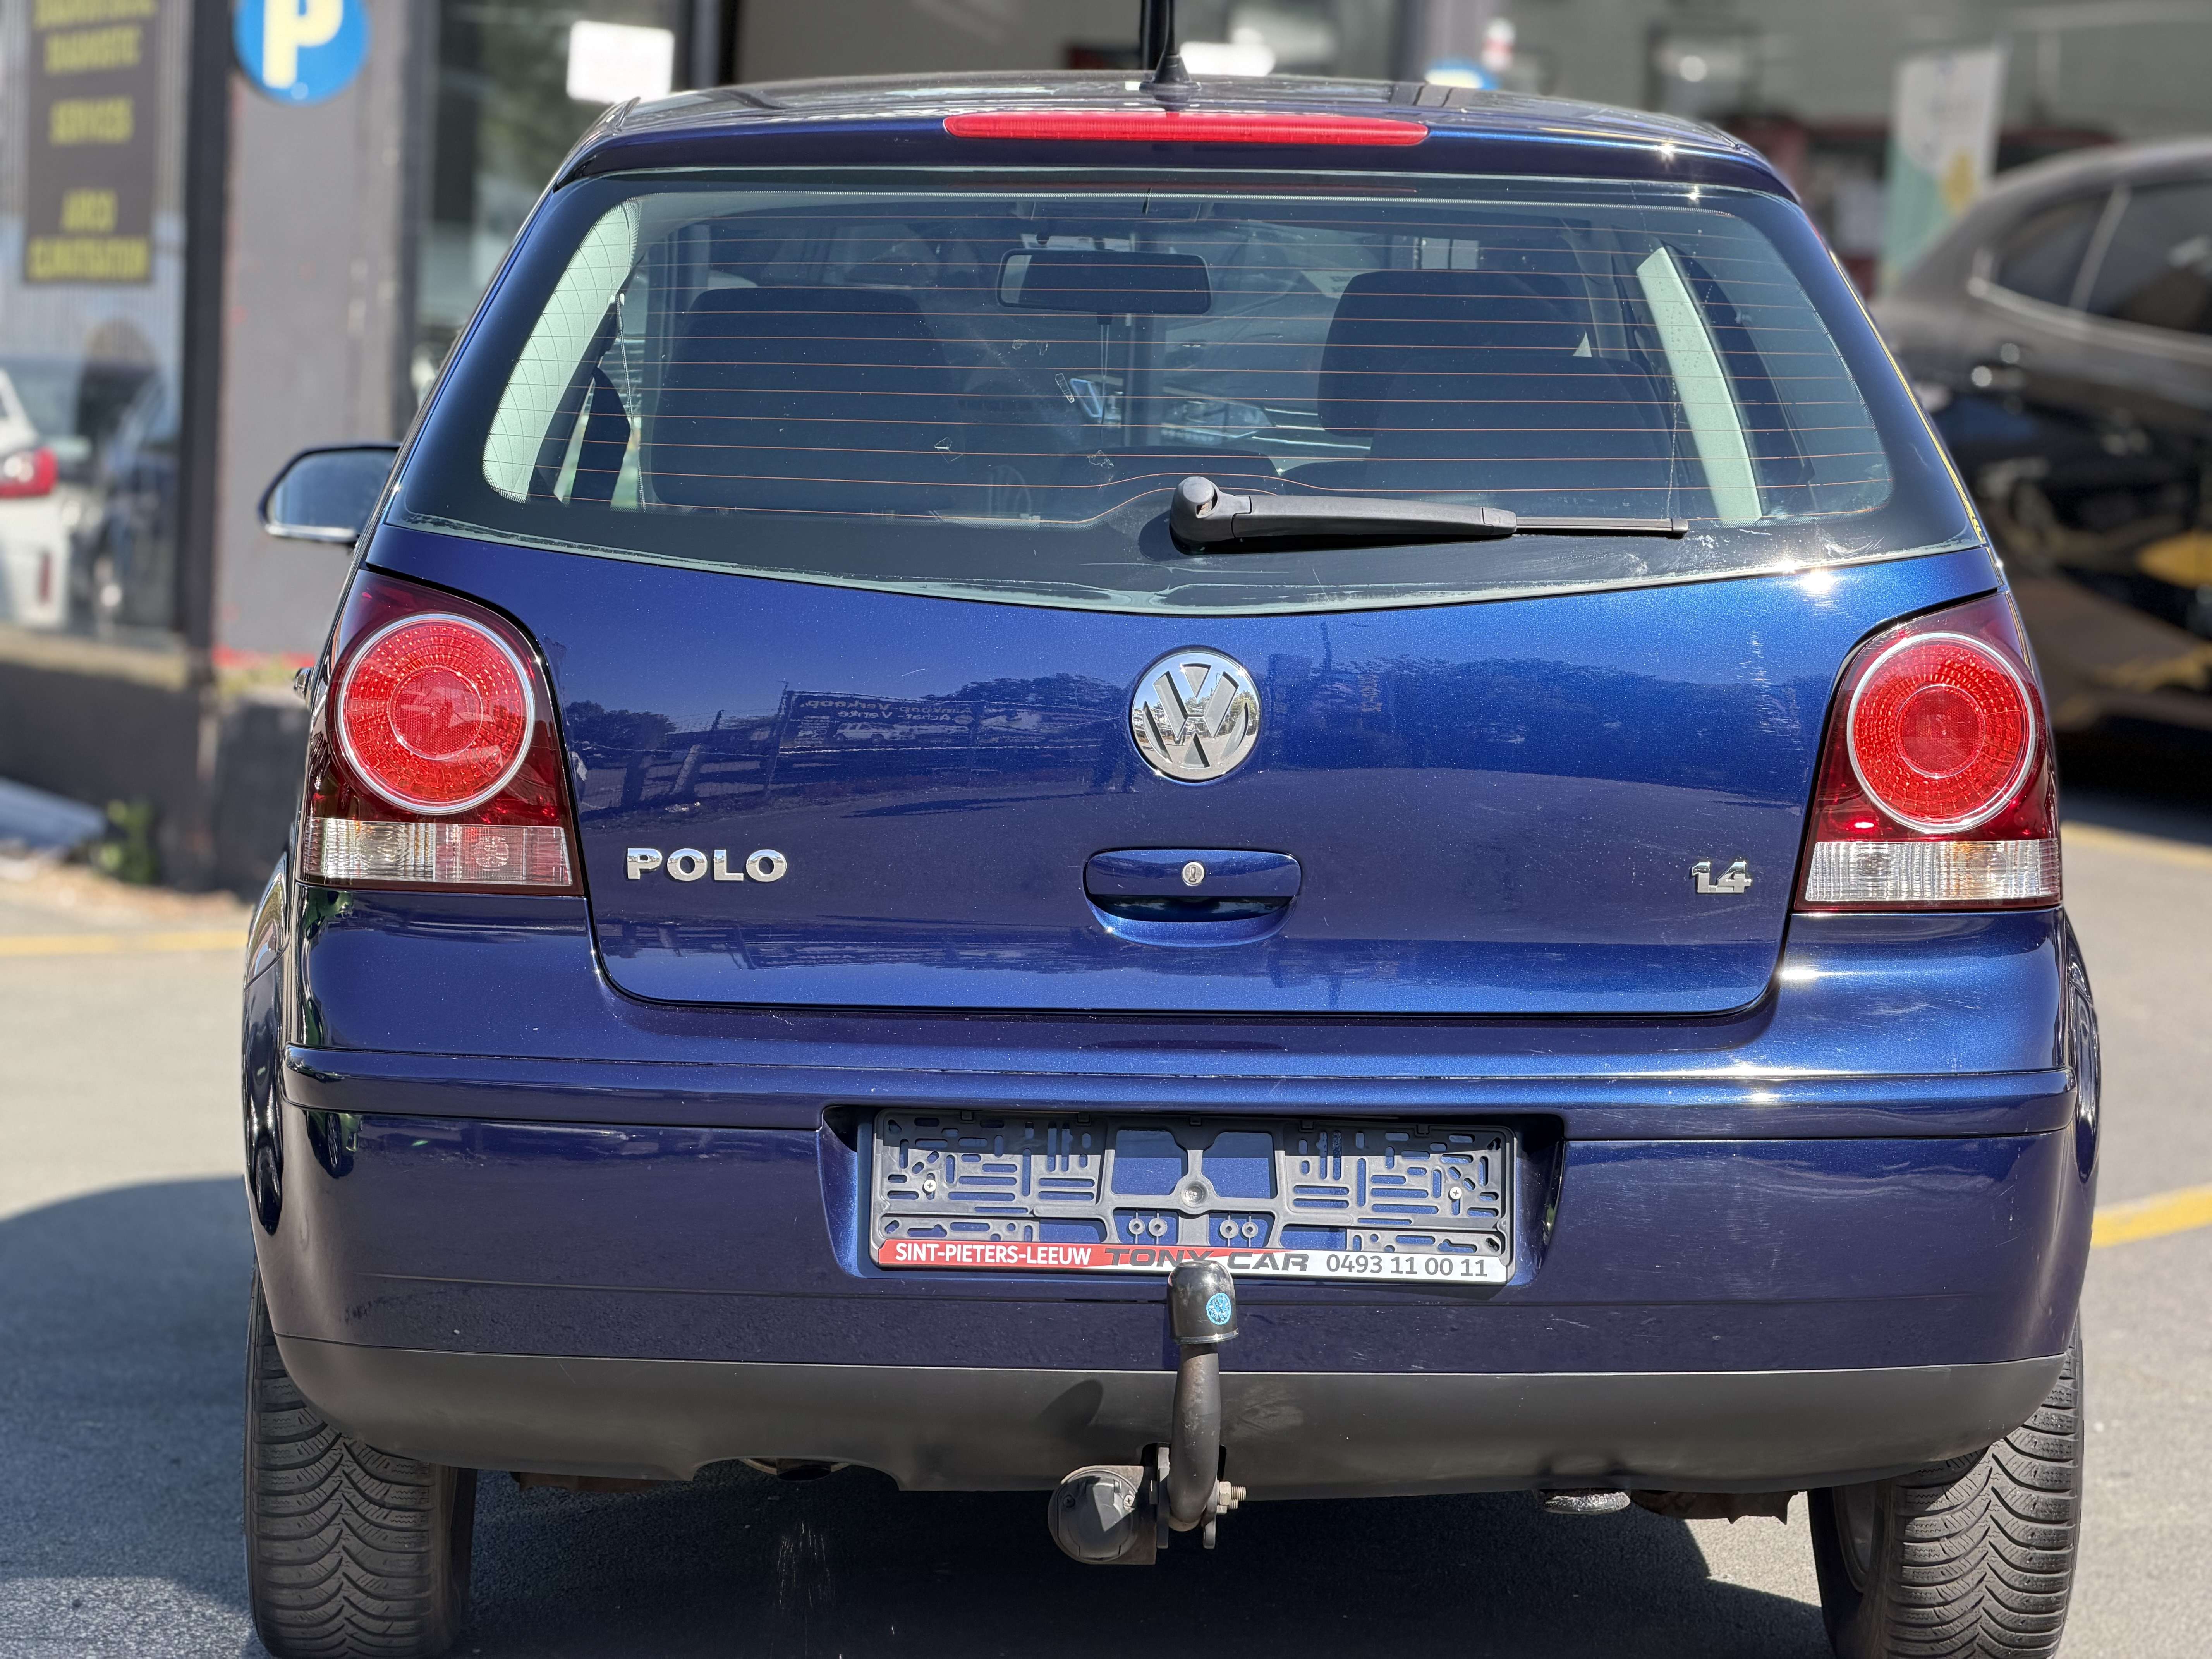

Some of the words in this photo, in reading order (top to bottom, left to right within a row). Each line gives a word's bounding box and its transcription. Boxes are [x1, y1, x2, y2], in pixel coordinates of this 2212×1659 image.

[627, 847, 787, 882] POLO
[1691, 861, 1752, 893] 1.4
[895, 1242, 1092, 1265] SINT-PIETERS-LEEUW
[1227, 1251, 1309, 1271] CAR
[1326, 1254, 1382, 1274] 0493
[1391, 1256, 1417, 1275] 11
[1425, 1257, 1453, 1276] 00
[1461, 1259, 1488, 1277] 11
